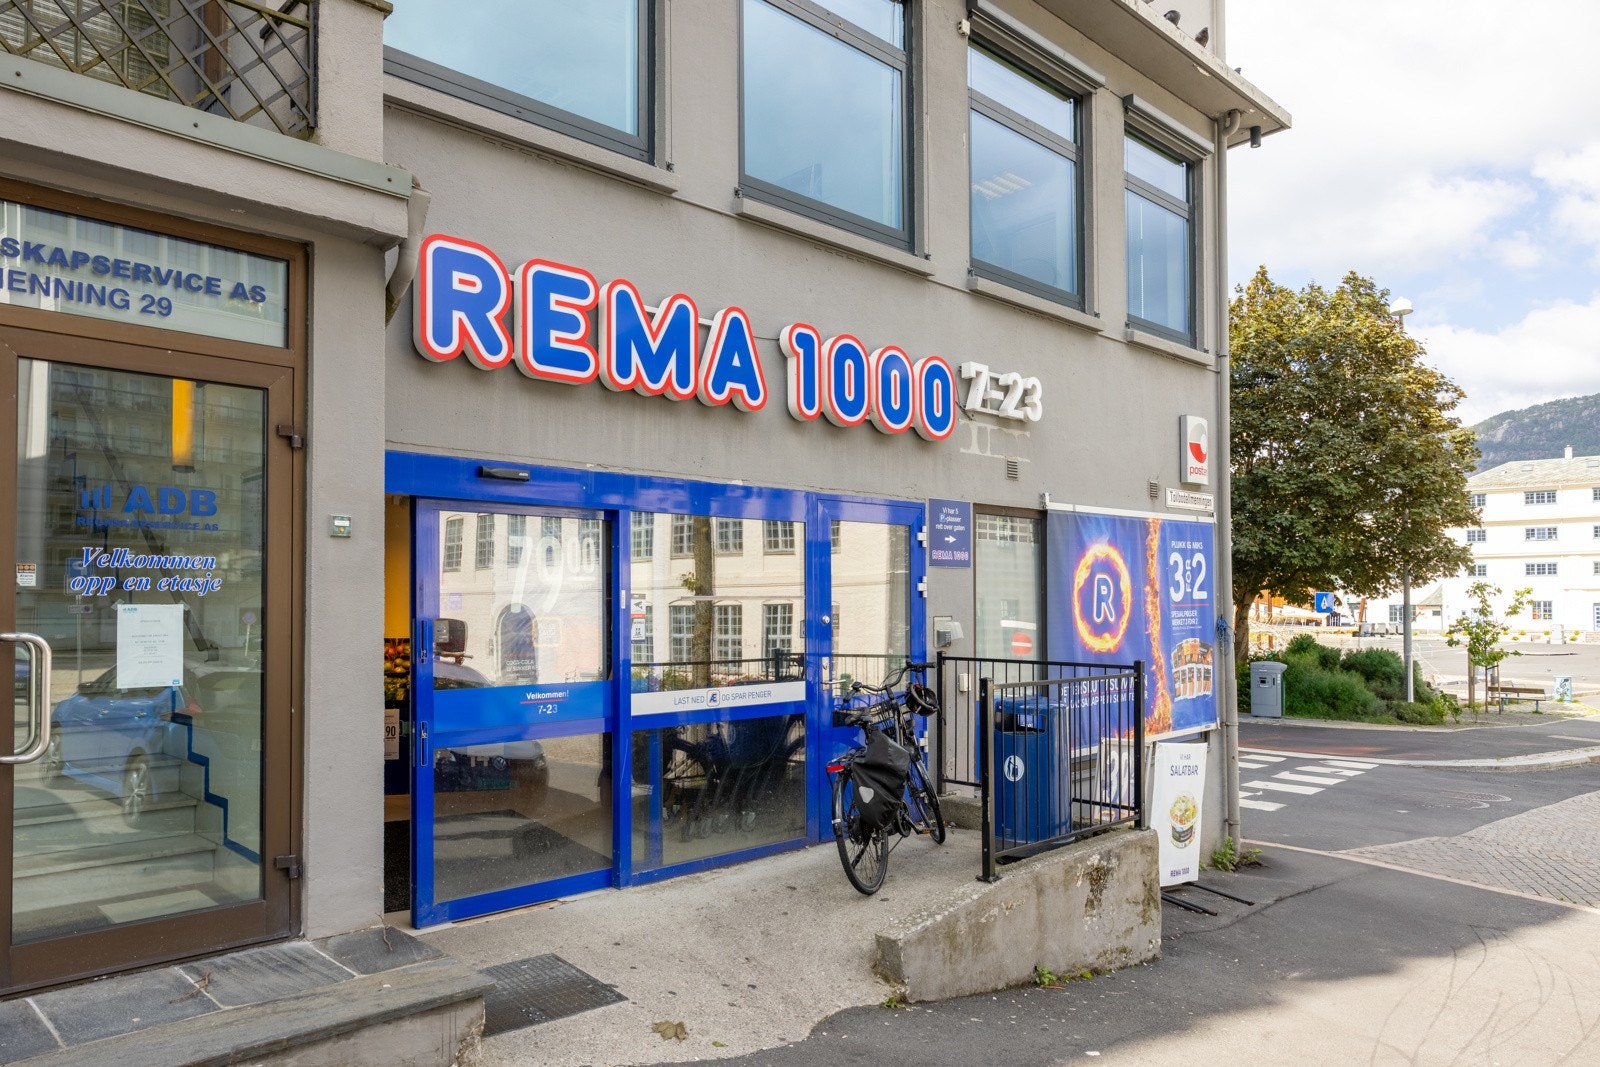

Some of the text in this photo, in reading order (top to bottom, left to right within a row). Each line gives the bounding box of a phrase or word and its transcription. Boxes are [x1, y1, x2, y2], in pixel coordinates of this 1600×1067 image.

[0, 236, 266, 304] SKAPSERVICE AS
[140, 293, 173, 317] 29
[416, 233, 957, 441] REMA 1000
[959, 361, 1043, 424] 7-23
[122, 484, 217, 516] ADB
[204, 522, 219, 531] AS
[932, 549, 968, 561] REMA 1000
[1171, 540, 1186, 549] PLUKK
[82, 546, 216, 569] Velkommen
[70, 572, 222, 596] opp en etasje
[508, 536, 564, 614] 79
[1169, 552, 1185, 603] 3
[1192, 552, 1207, 600] 2
[526, 690, 569, 700] Velkommen!
[673, 696, 690, 706] LAST
[691, 695, 705, 704] NED
[721, 693, 731, 702] OG
[731, 692, 747, 701] SPAR
[747, 690, 772, 699] PENGER
[385, 725, 396, 737] 90
[1170, 764, 1199, 776] SALATBAR
